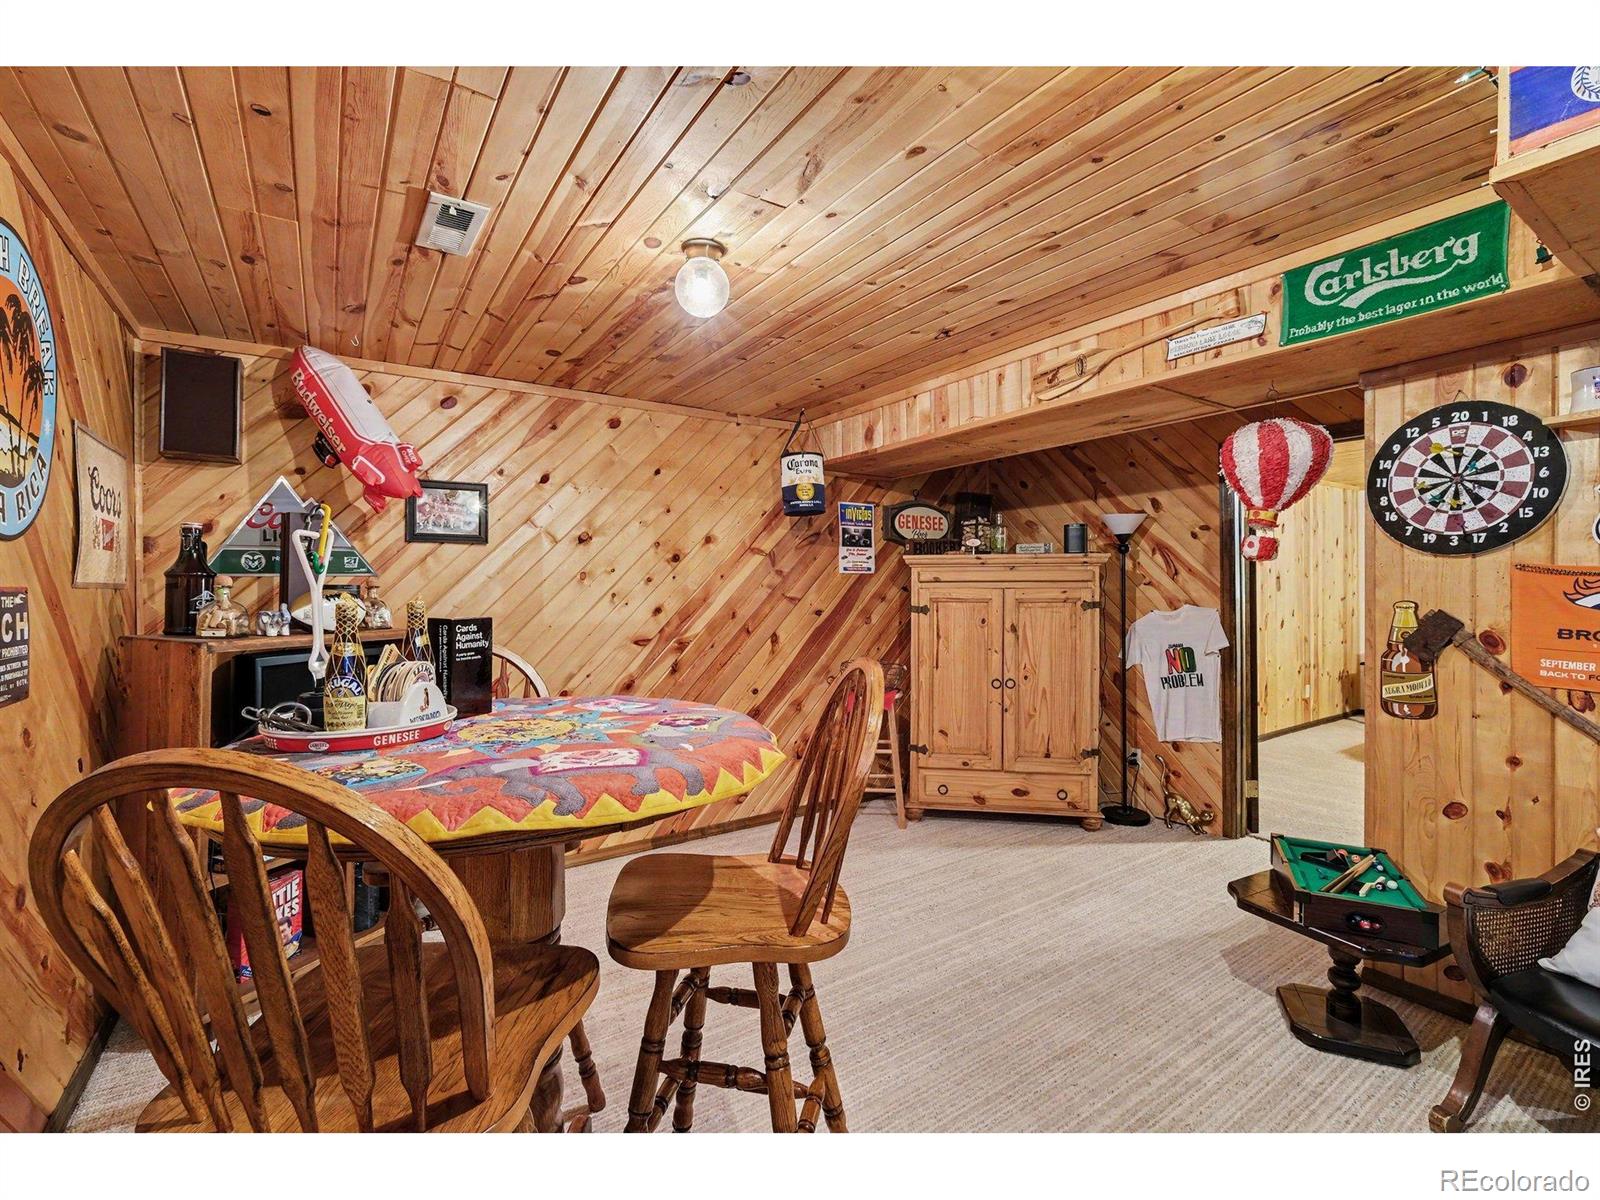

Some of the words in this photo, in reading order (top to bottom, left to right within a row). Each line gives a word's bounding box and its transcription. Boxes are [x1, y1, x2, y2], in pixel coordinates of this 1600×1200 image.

[1304, 232, 1481, 309] Carlsberg
[1288, 319, 1335, 339] Probably
[1336, 314, 1356, 327] the
[1358, 308, 1384, 322] best
[1385, 300, 1417, 317] lager
[1419, 297, 1434, 306] in
[1436, 287, 1460, 302] the
[1464, 272, 1504, 295] world
[18, 254, 54, 396] BREAK
[291, 368, 346, 453] Budweiser
[1451, 410, 1470, 423] 20
[1482, 411, 1488, 422] 1
[1432, 417, 1441, 428] 5
[1502, 414, 1519, 428] 18
[1406, 427, 1420, 439] 12
[1522, 430, 1534, 442] 4
[1392, 443, 1401, 454] 9
[1533, 446, 1550, 458] 13
[786, 459, 819, 471] Corona
[1379, 459, 1392, 471] 14
[1538, 466, 1550, 478] 6
[16, 452, 47, 521] RICA
[1376, 478, 1387, 488] 11
[87, 466, 122, 519] Coors
[1532, 487, 1549, 499] 10
[1379, 496, 1389, 507] 8
[1384, 512, 1398, 522] 16
[1519, 506, 1534, 519] 15
[898, 513, 944, 531] GENESEE
[1498, 522, 1509, 534] 2
[1405, 525, 1414, 537] 7
[1422, 533, 1437, 544] 19
[1449, 535, 1459, 547] 3
[1472, 532, 1487, 544] 17
[1, 597, 14, 608] THE
[456, 624, 477, 632] Cards
[456, 632, 483, 642] Against
[456, 640, 489, 650] Humanity
[1165, 646, 1197, 675] NO
[1540, 659, 1596, 671] SEPTEMBER
[1540, 670, 1569, 678] BACK
[1571, 672, 1586, 680] TO
[1160, 673, 1204, 690] PROBLEM
[1384, 685, 1406, 695] NEGRA
[1406, 679, 1432, 692] MODELO
[373, 730, 420, 746] GENESEE
